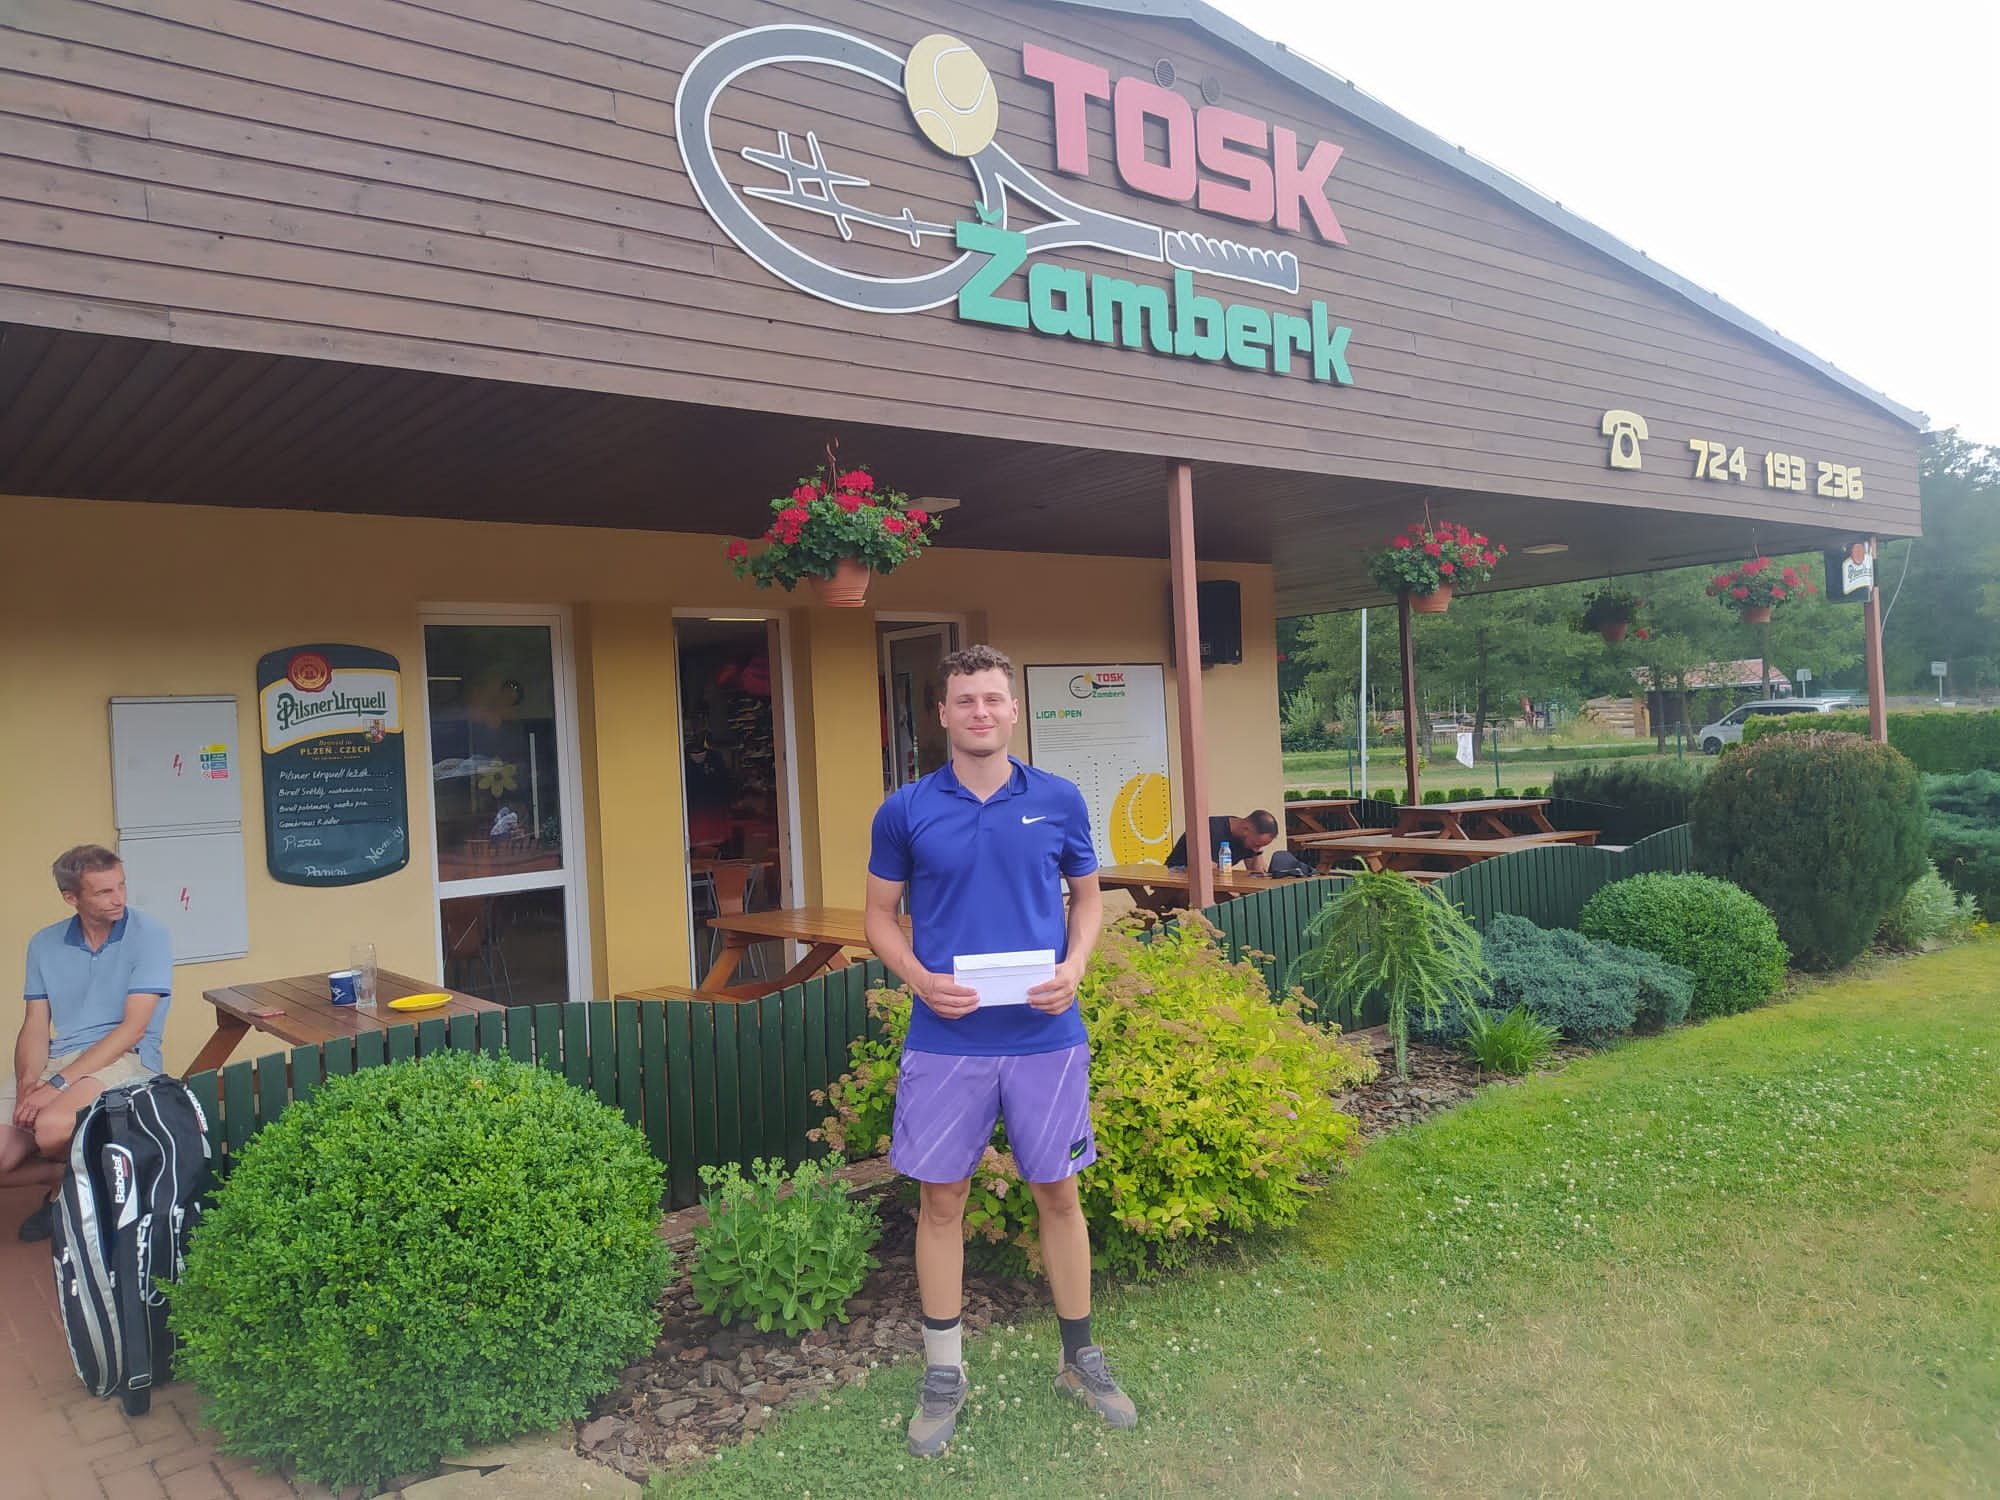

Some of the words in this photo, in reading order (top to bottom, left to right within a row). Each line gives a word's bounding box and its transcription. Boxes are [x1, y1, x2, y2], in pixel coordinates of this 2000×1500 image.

[1023, 41, 1349, 245] TOSK
[956, 200, 1354, 385] Žamberk
[1688, 439, 1747, 481] 724
[1765, 451, 1807, 491] 193
[1817, 461, 1864, 500] 236
[1096, 673, 1124, 682] TOSK
[277, 692, 333, 731] Pilsner
[332, 691, 386, 717] Urquell
[1036, 710, 1056, 720] LIGA
[339, 745, 371, 754] CZECH
[283, 835, 322, 852] Pizza
[112, 1153, 125, 1203] Babolat
